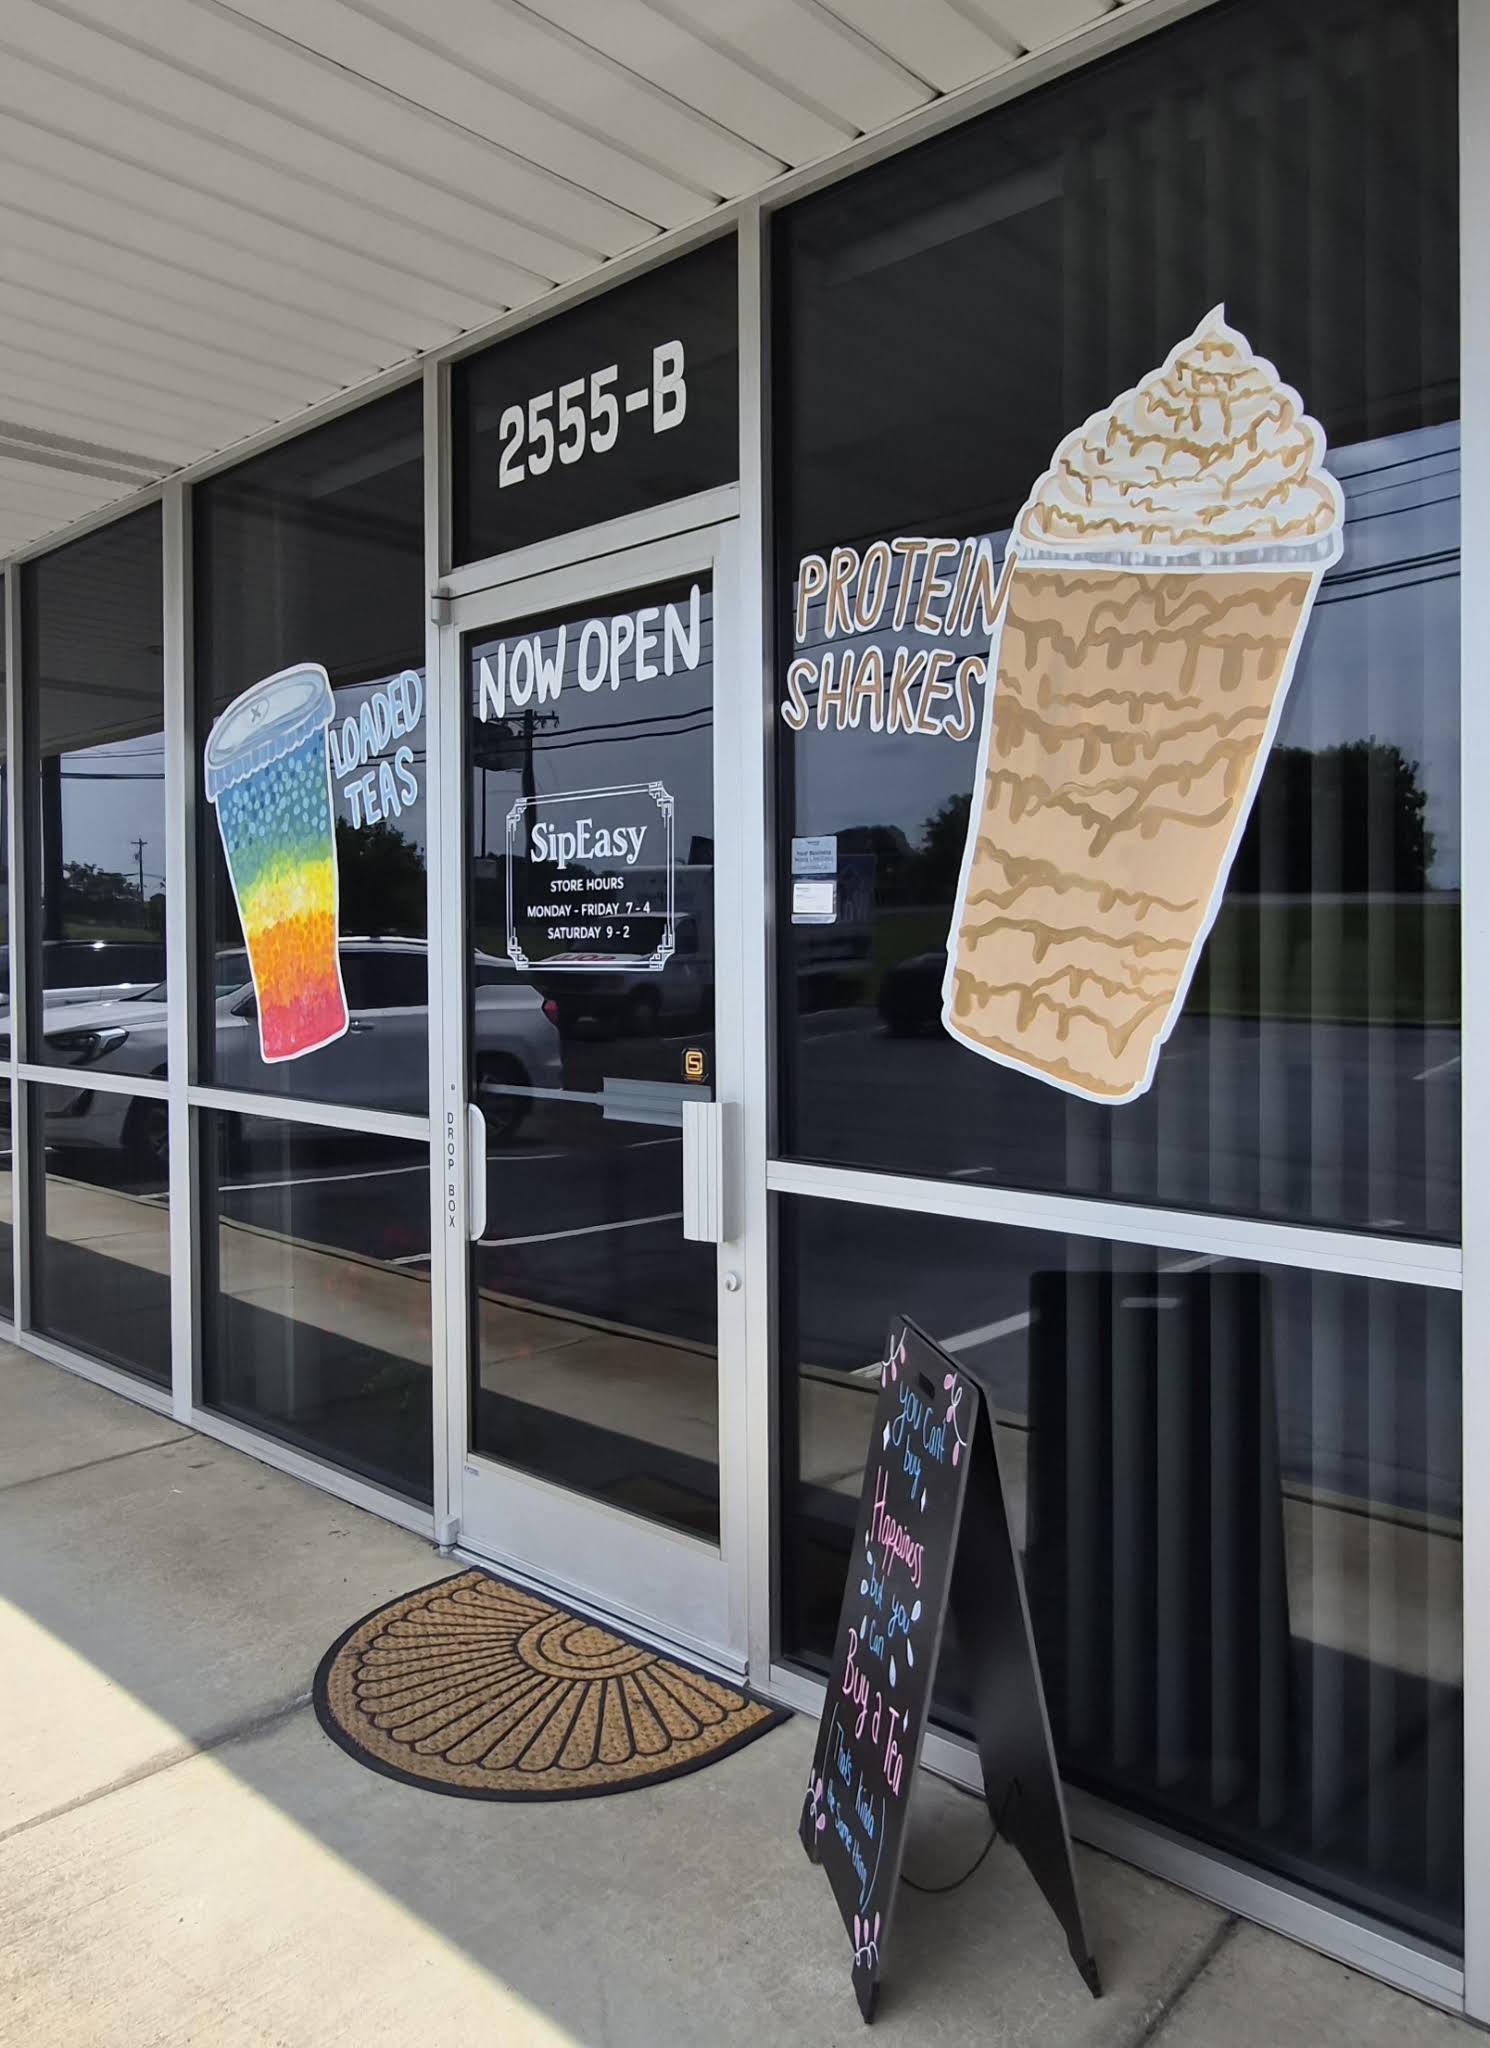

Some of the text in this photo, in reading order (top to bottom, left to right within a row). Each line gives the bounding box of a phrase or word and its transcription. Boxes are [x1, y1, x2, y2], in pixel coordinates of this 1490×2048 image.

[499, 340, 687, 488] 2555-B
[796, 536, 1017, 643] PROTEIN
[479, 584, 700, 723] NOW OPEN
[781, 645, 988, 742] SHAKES
[329, 669, 423, 779] LOADED
[344, 746, 418, 830] TEAS
[530, 818, 648, 869] SipEasy
[550, 876, 625, 893] STORE HOURS
[527, 904, 572, 918] MONDAY
[581, 902, 620, 917] FRIDAY
[625, 901, 633, 914] 7
[642, 901, 651, 914] 4
[547, 926, 602, 940] SATURDAY
[606, 925, 613, 939] 9
[622, 925, 631, 938] 2
[447, 1112, 456, 1228] DROP BOX
[892, 1381, 922, 1446] you
[903, 1434, 921, 1499] buy
[870, 1465, 924, 1589] Happiness
[887, 1594, 910, 1638] you
[842, 1627, 904, 1796] Buy a Tea
